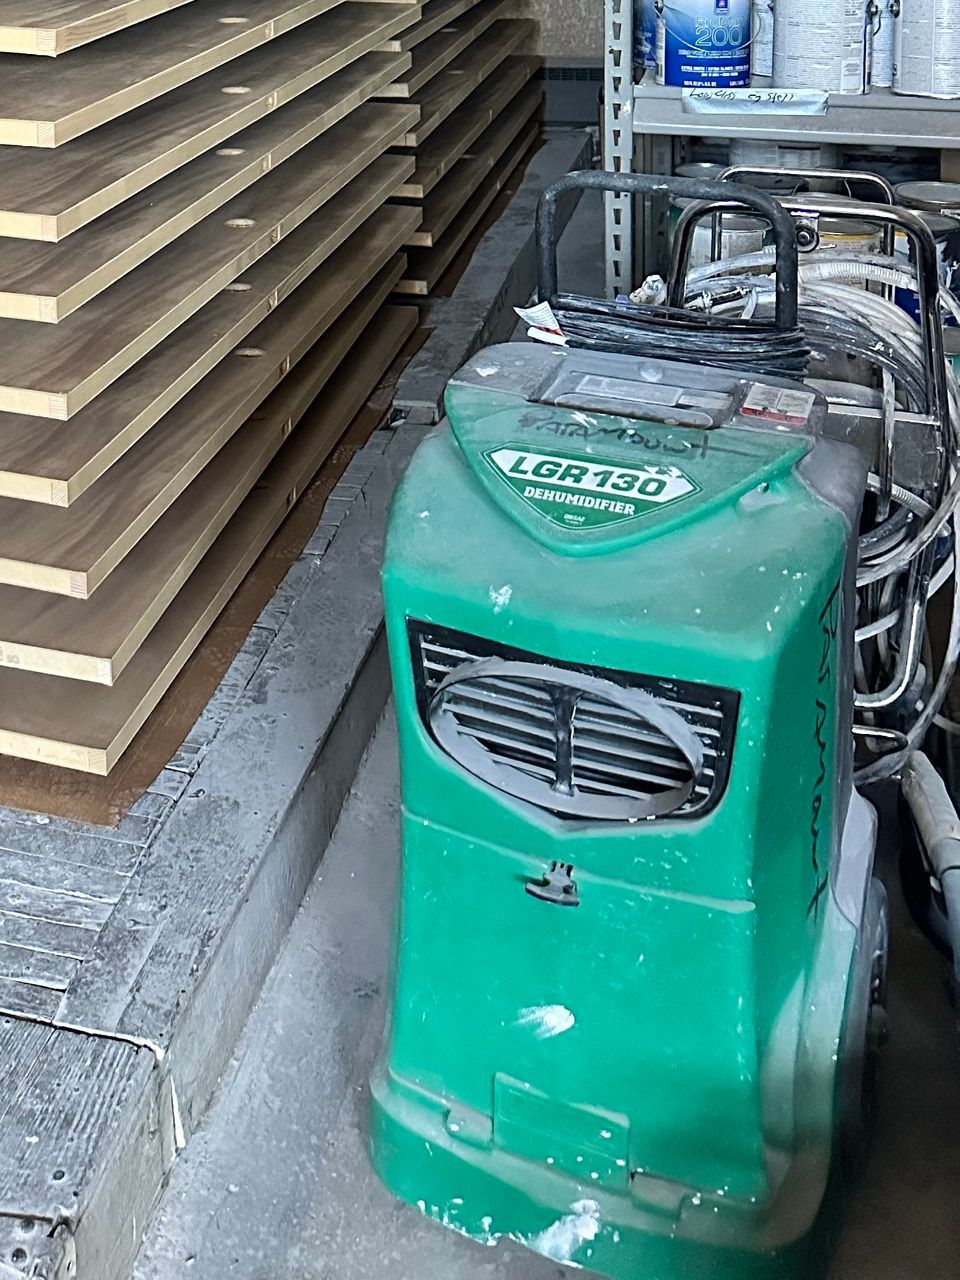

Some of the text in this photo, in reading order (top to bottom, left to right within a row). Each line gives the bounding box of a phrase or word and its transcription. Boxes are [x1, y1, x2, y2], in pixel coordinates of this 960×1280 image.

[695, 26, 743, 46] 200
[508, 456, 668, 498] LGR 130
[523, 486, 636, 516] DEHUMIDIFIER
